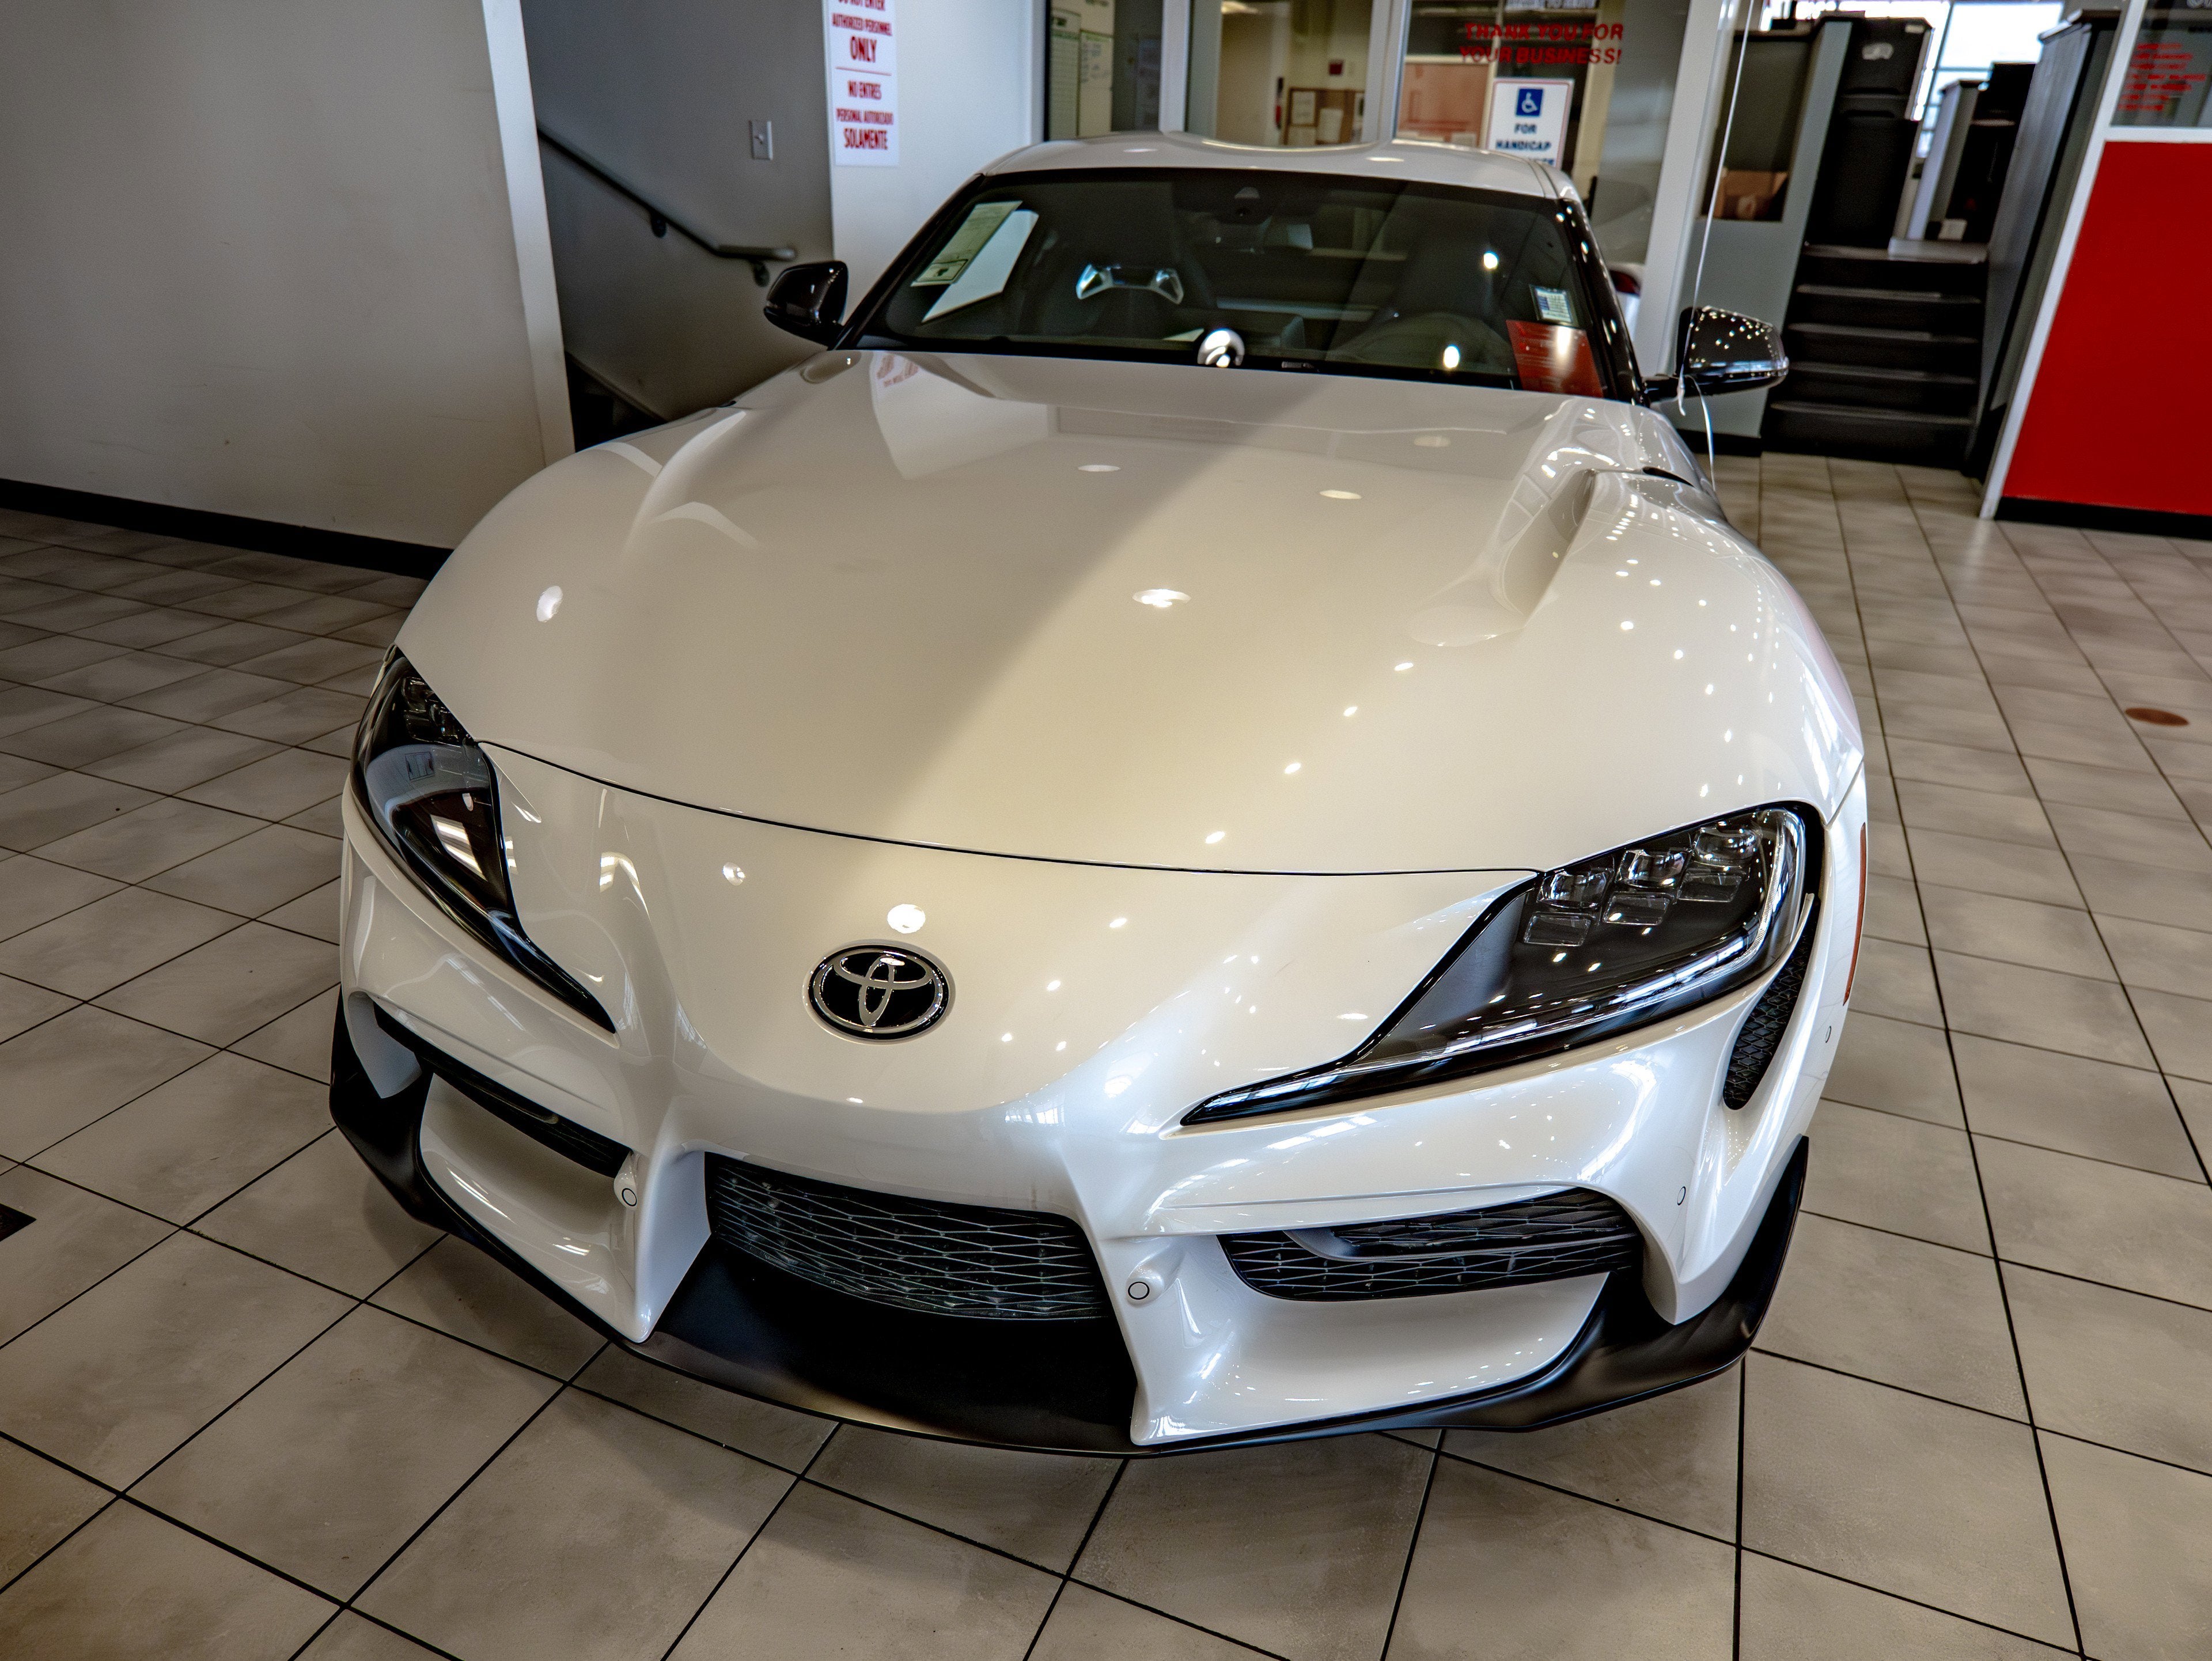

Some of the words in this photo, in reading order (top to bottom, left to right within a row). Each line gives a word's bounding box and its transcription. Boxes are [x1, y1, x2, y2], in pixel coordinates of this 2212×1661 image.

[832, 13, 863, 31] AUTHORIZED
[865, 18, 892, 36] PERSONNEL
[1465, 23, 1530, 39] THANK
[1537, 22, 1577, 40] YOU
[1581, 23, 1623, 40] FOR
[850, 36, 877, 62] ONLY
[1459, 46, 1513, 63] YOUR
[1515, 47, 1622, 64] BUSINESS!
[847, 80, 857, 97] NO
[858, 82, 882, 100] ENTRES
[836, 108, 862, 123] PERSONAL
[1514, 123, 1537, 134] FOR
[843, 128, 888, 150] SOLAMENTE
[1495, 140, 1552, 151] HANDICAP
